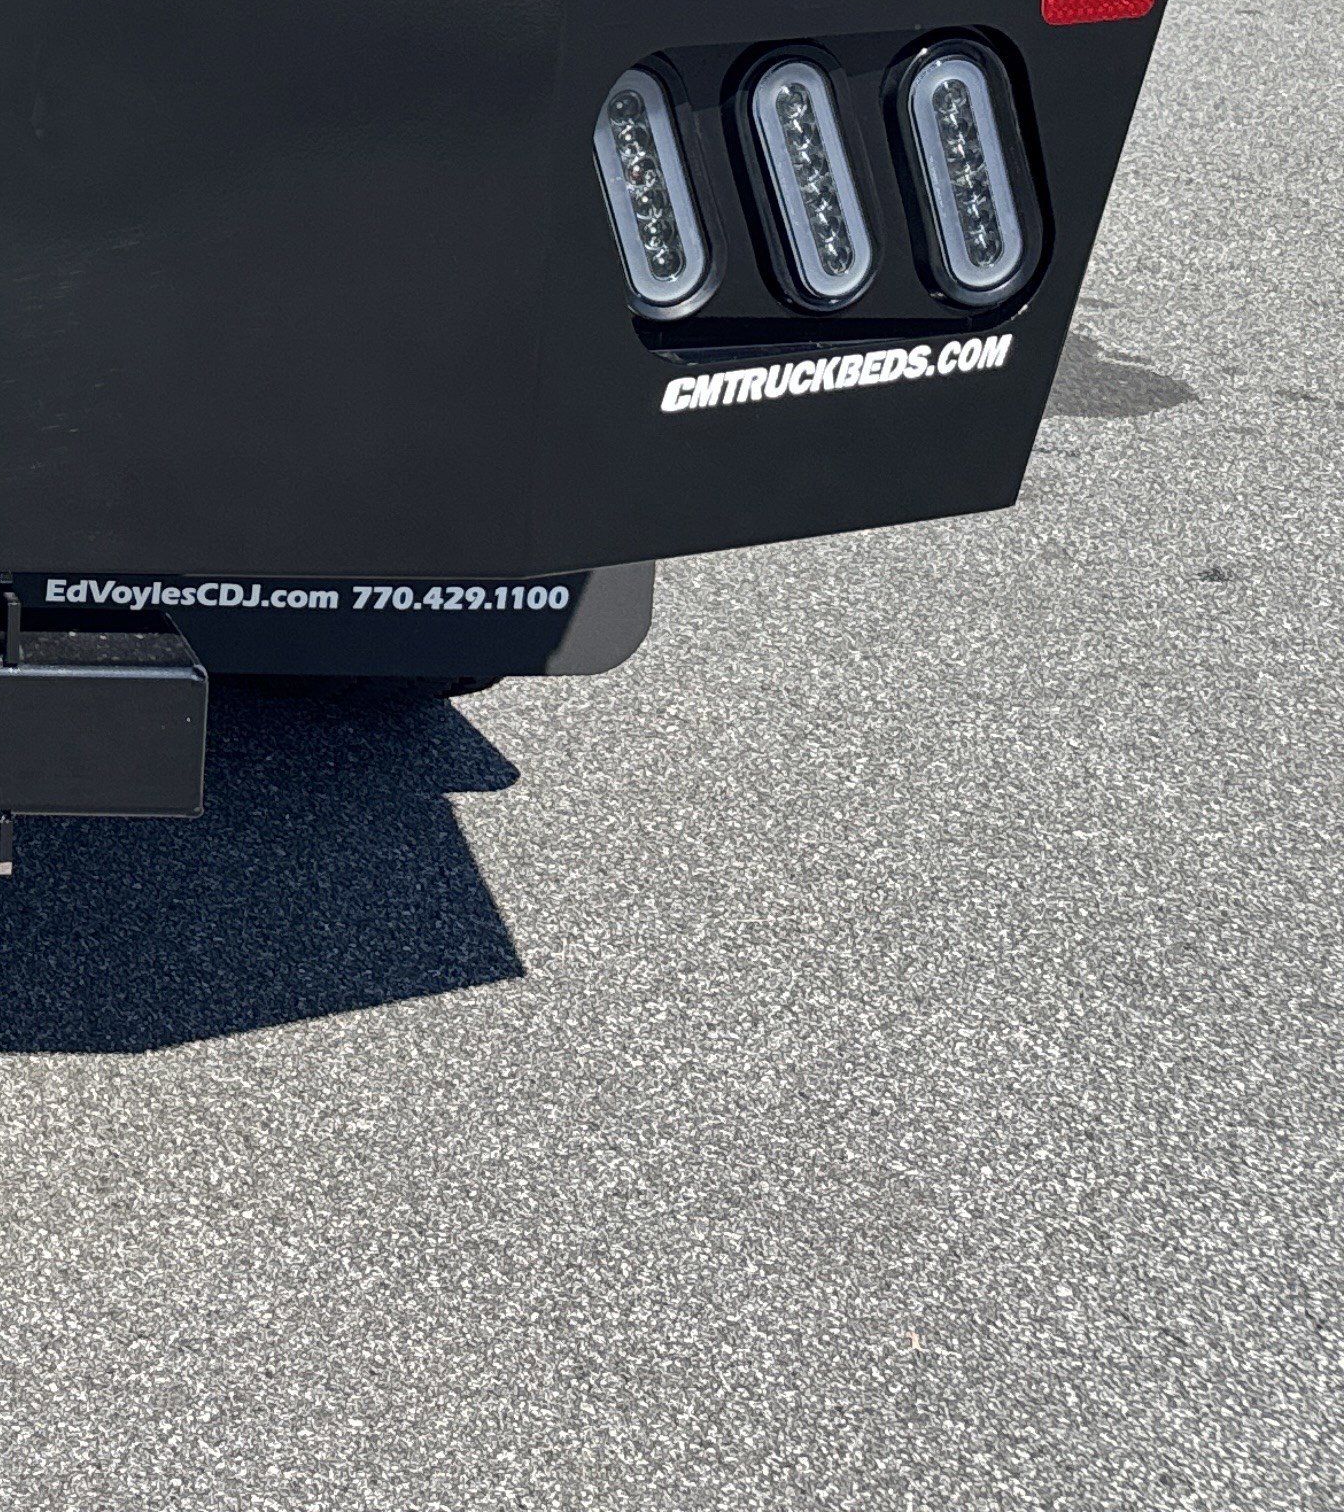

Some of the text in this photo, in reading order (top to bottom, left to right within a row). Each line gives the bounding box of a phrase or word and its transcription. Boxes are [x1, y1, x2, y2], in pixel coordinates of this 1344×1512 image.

[660, 333, 1013, 413] CMTRUCKBEDS.COM
[45, 579, 569, 611] EdVoylesCDJ.com 770.429.1100
